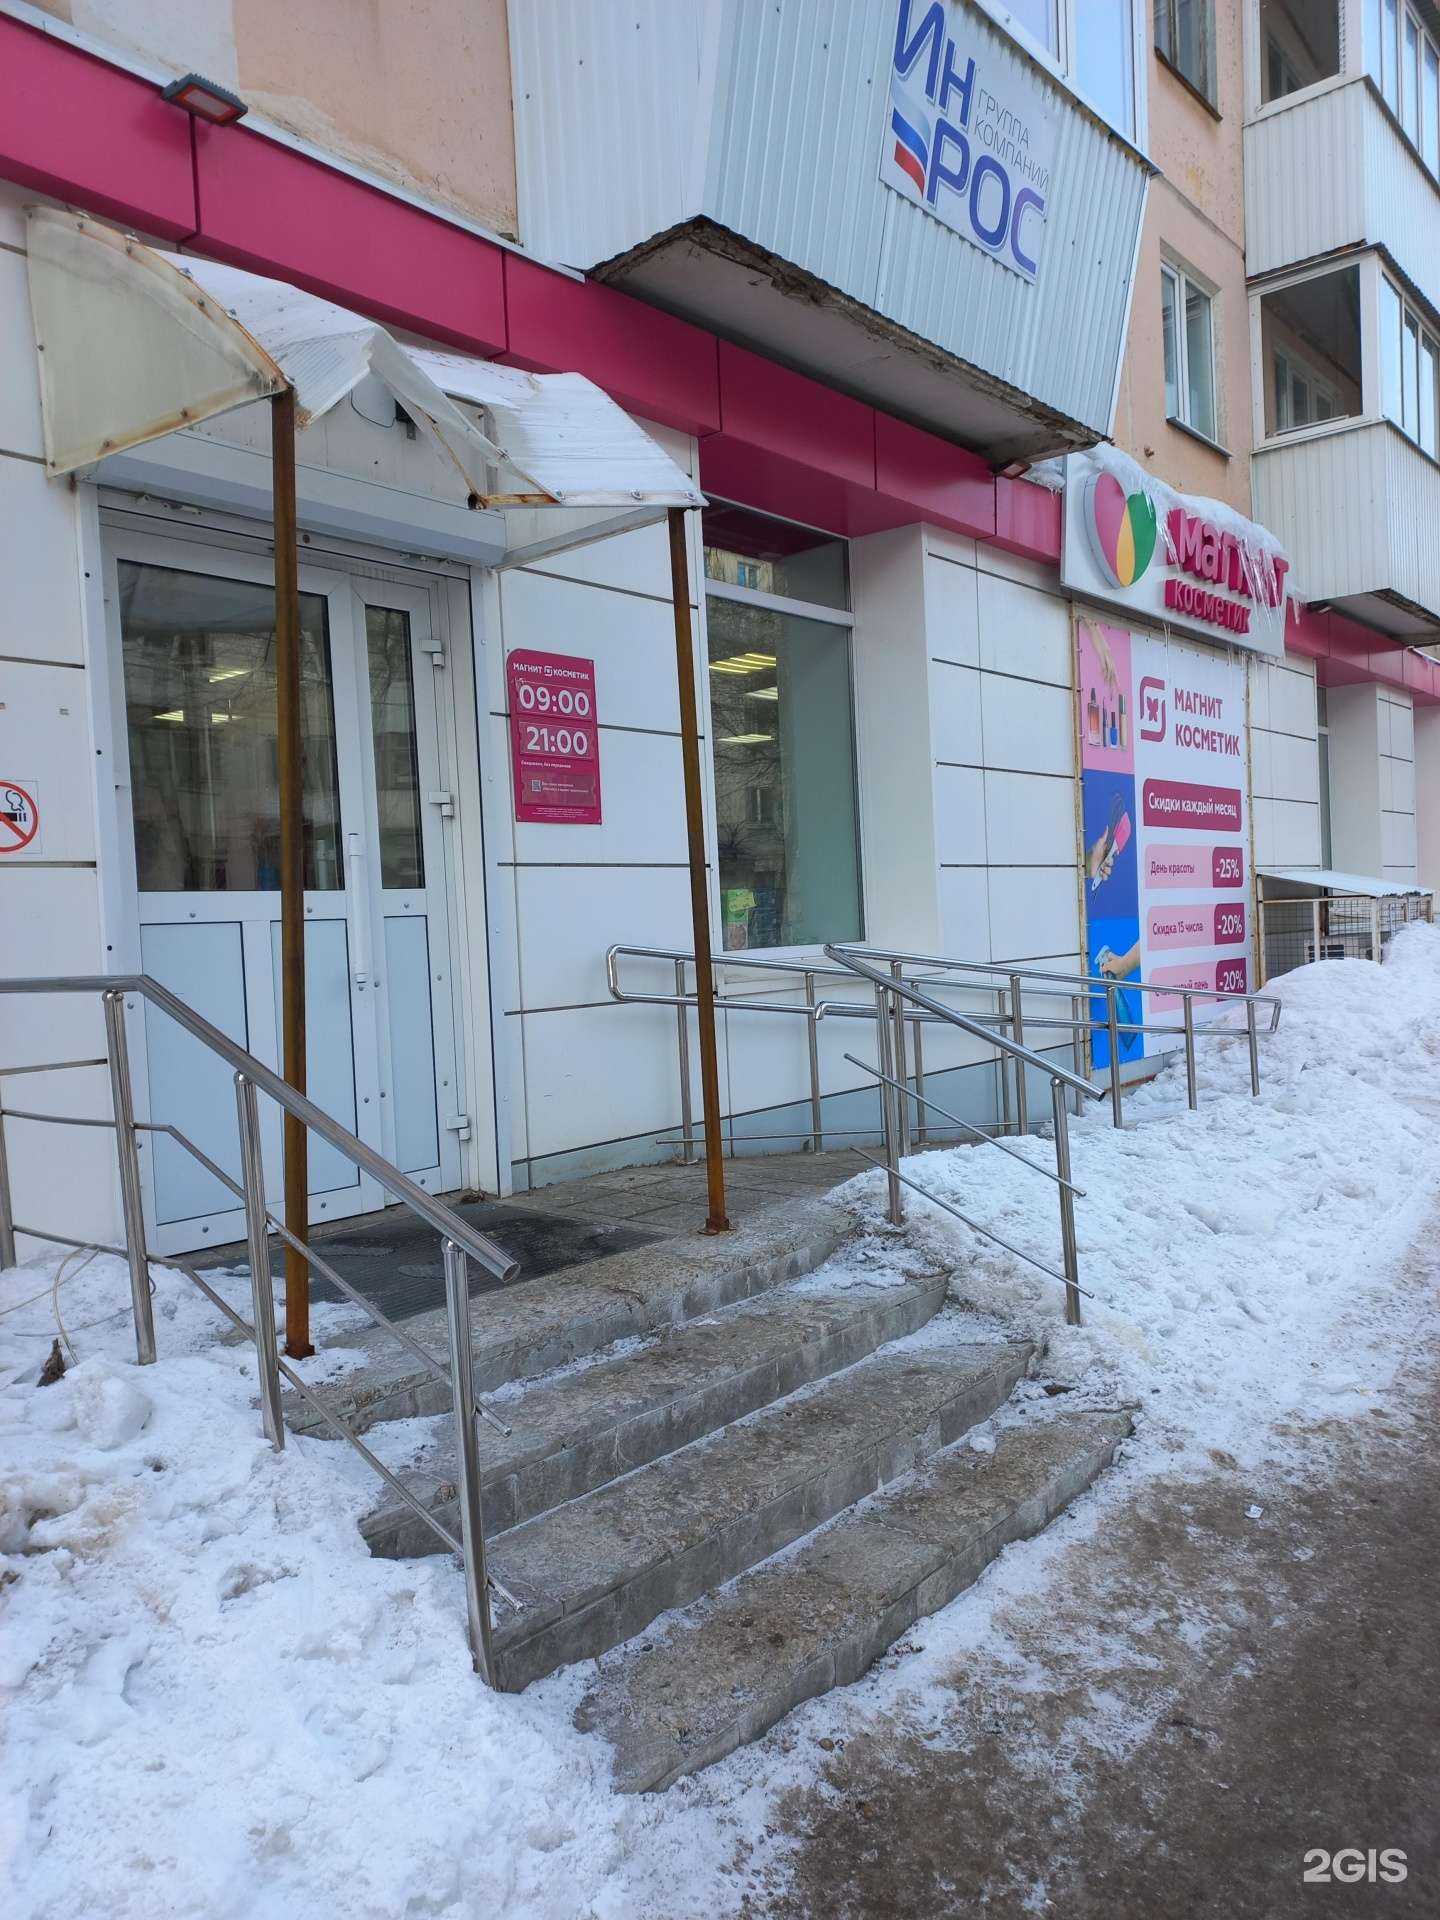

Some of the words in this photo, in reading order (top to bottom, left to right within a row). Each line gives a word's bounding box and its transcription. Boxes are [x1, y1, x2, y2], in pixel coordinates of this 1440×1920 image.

[894, 0, 976, 126] ИН
[978, 88, 1030, 148] ГРУППА
[974, 117, 1049, 191] КОМПАНИЙ
[927, 117, 1045, 275] РОС
[513, 662, 542, 674] МАГНИТ
[553, 669, 590, 681] КОСМЕТИК
[519, 684, 590, 716] 09:00
[1174, 687, 1223, 719] МАГНИТ
[526, 726, 588, 755] 21:00
[1175, 723, 1241, 756] КОСМЕТИК
[1149, 792, 1180, 813] Скидки
[1181, 798, 1214, 815] каждый
[1215, 803, 1237, 818] месяц
[1151, 861, 1168, 876] День
[1168, 864, 1195, 876] красоты
[1216, 858, 1240, 878] -25%
[1152, 923, 1177, 936] Скидка
[1178, 923, 1184, 933] 15
[1185, 922, 1203, 932] числа
[1217, 915, 1243, 935] -20%
[1219, 971, 1244, 991] -20%
